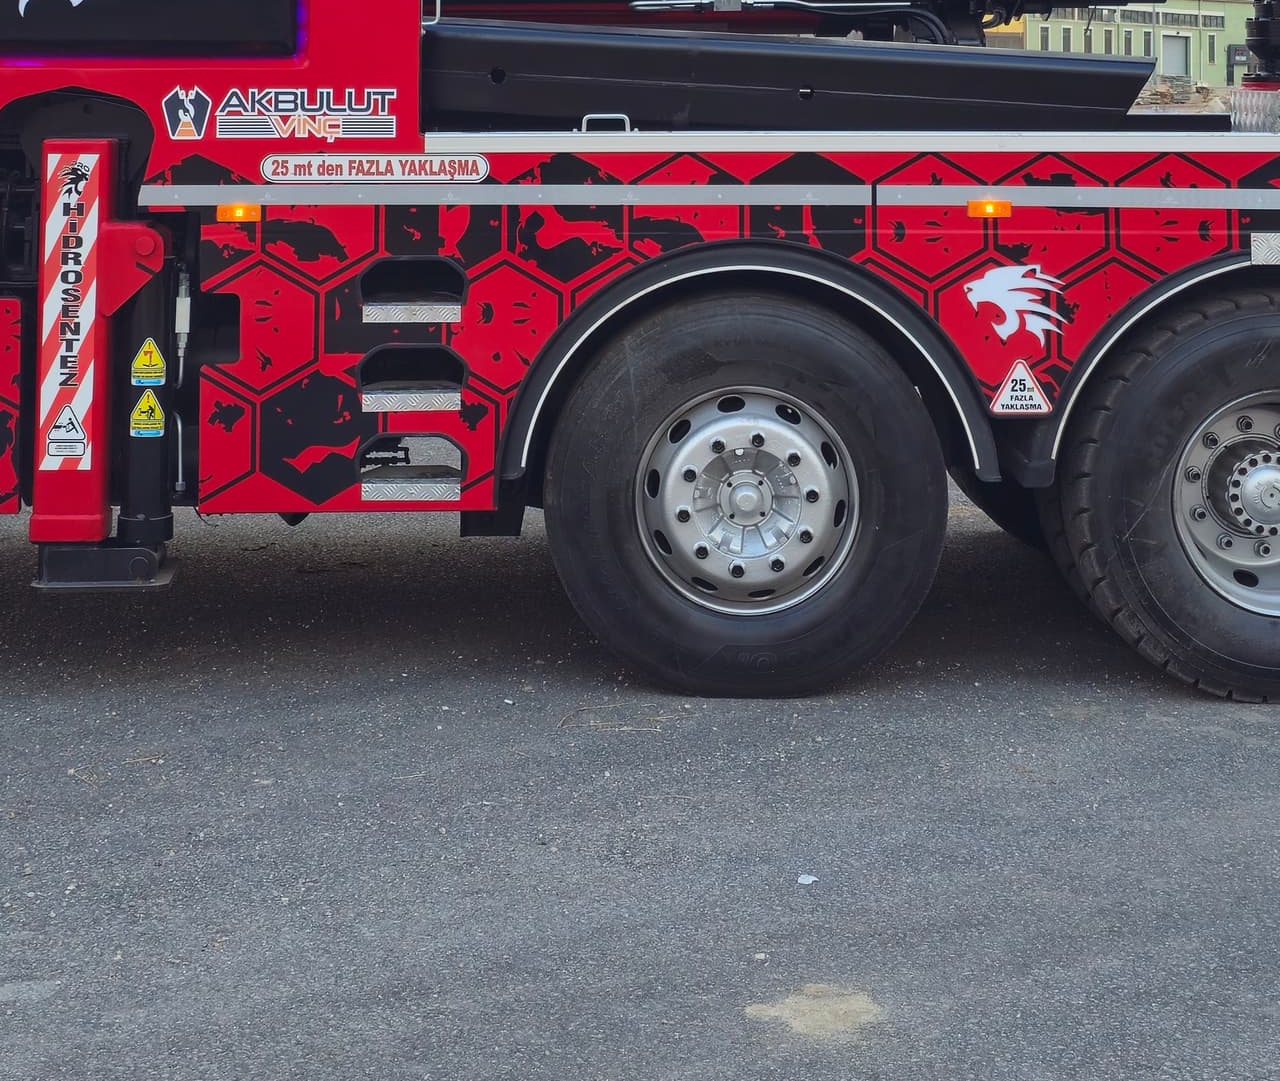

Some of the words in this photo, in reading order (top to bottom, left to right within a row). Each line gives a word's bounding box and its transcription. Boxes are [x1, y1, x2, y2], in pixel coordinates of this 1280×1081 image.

[217, 89, 395, 114] AKBULUT
[273, 114, 342, 142] VİNÇ
[271, 159, 289, 177] 25
[293, 160, 313, 177] mt
[317, 159, 343, 177] den
[348, 159, 393, 177] FAZLA
[398, 159, 480, 181] YAKLAŞMA
[1010, 378, 1027, 392] 25
[1010, 394, 1034, 402] FAZLA
